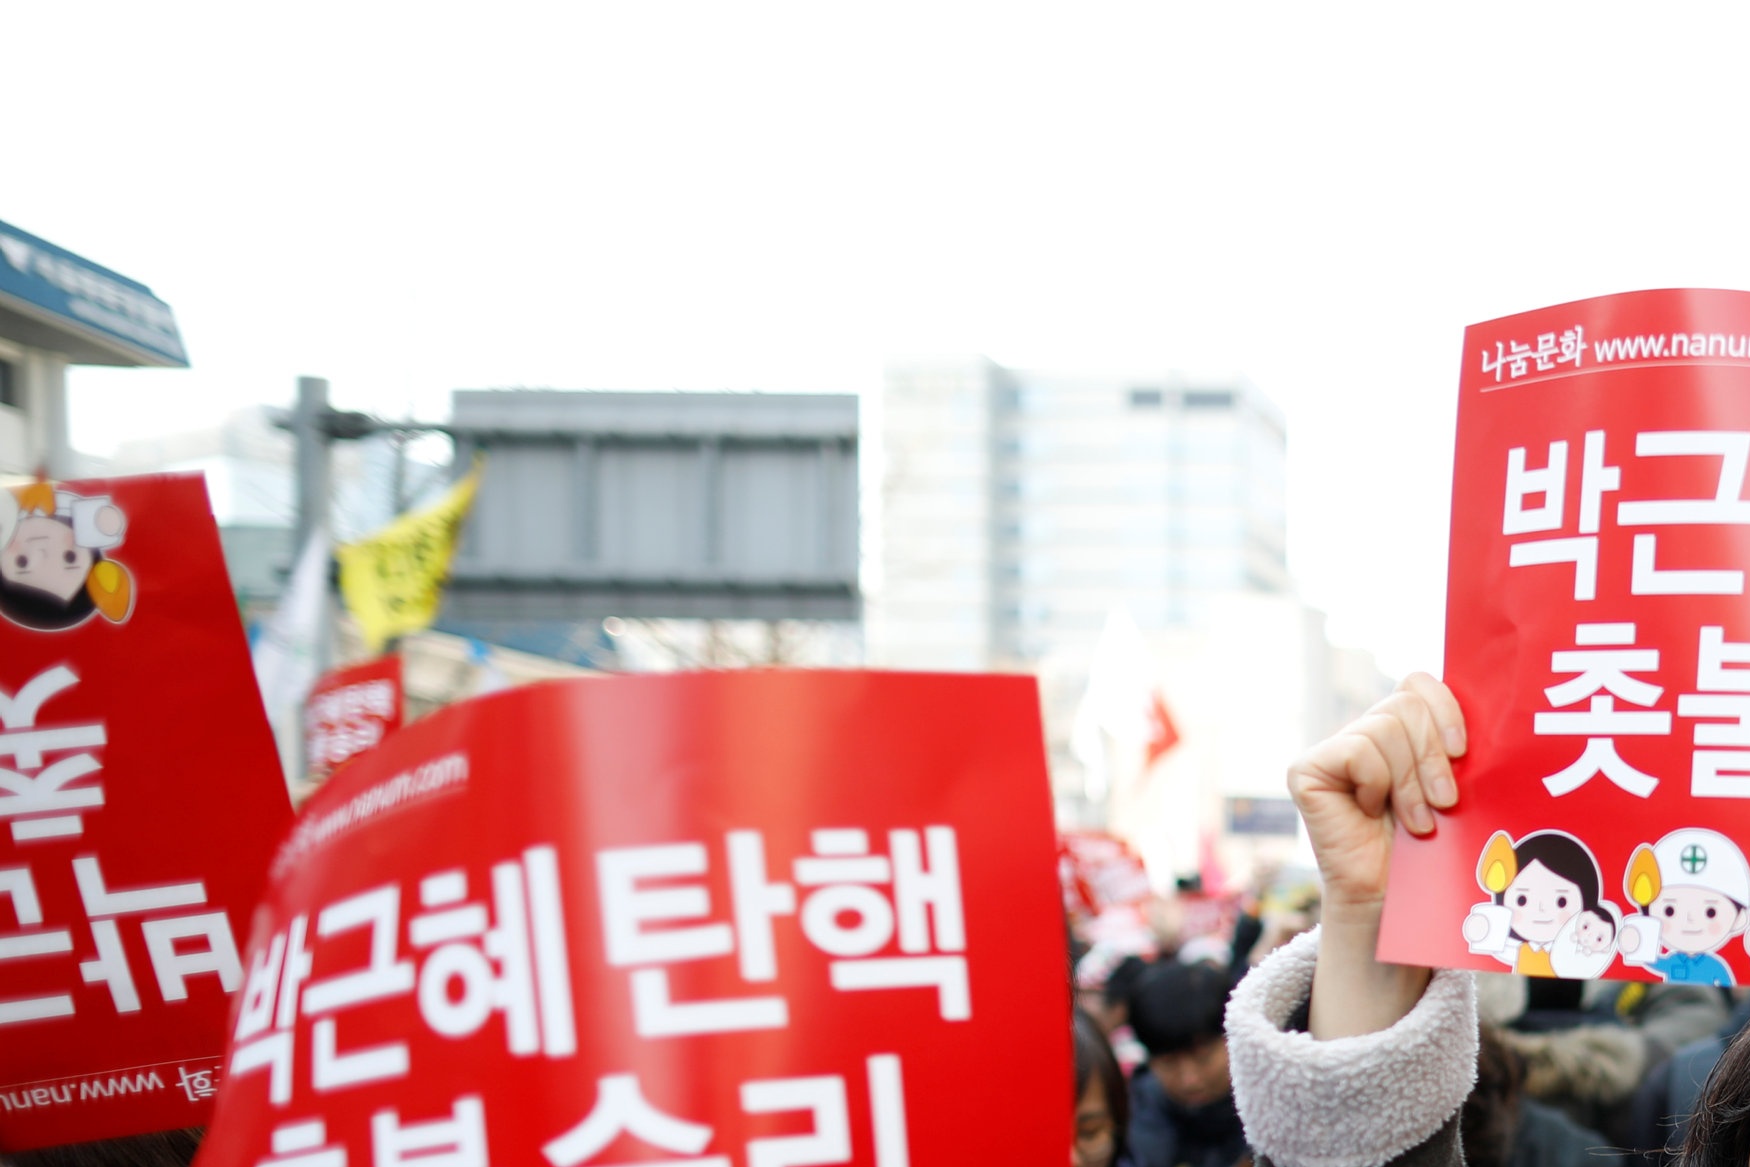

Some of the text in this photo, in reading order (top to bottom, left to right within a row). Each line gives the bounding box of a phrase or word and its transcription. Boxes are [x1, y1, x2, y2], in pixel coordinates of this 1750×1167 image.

[1480, 325, 1588, 382] 나눔문화
[226, 825, 972, 1105] 박근혜 탄핵
